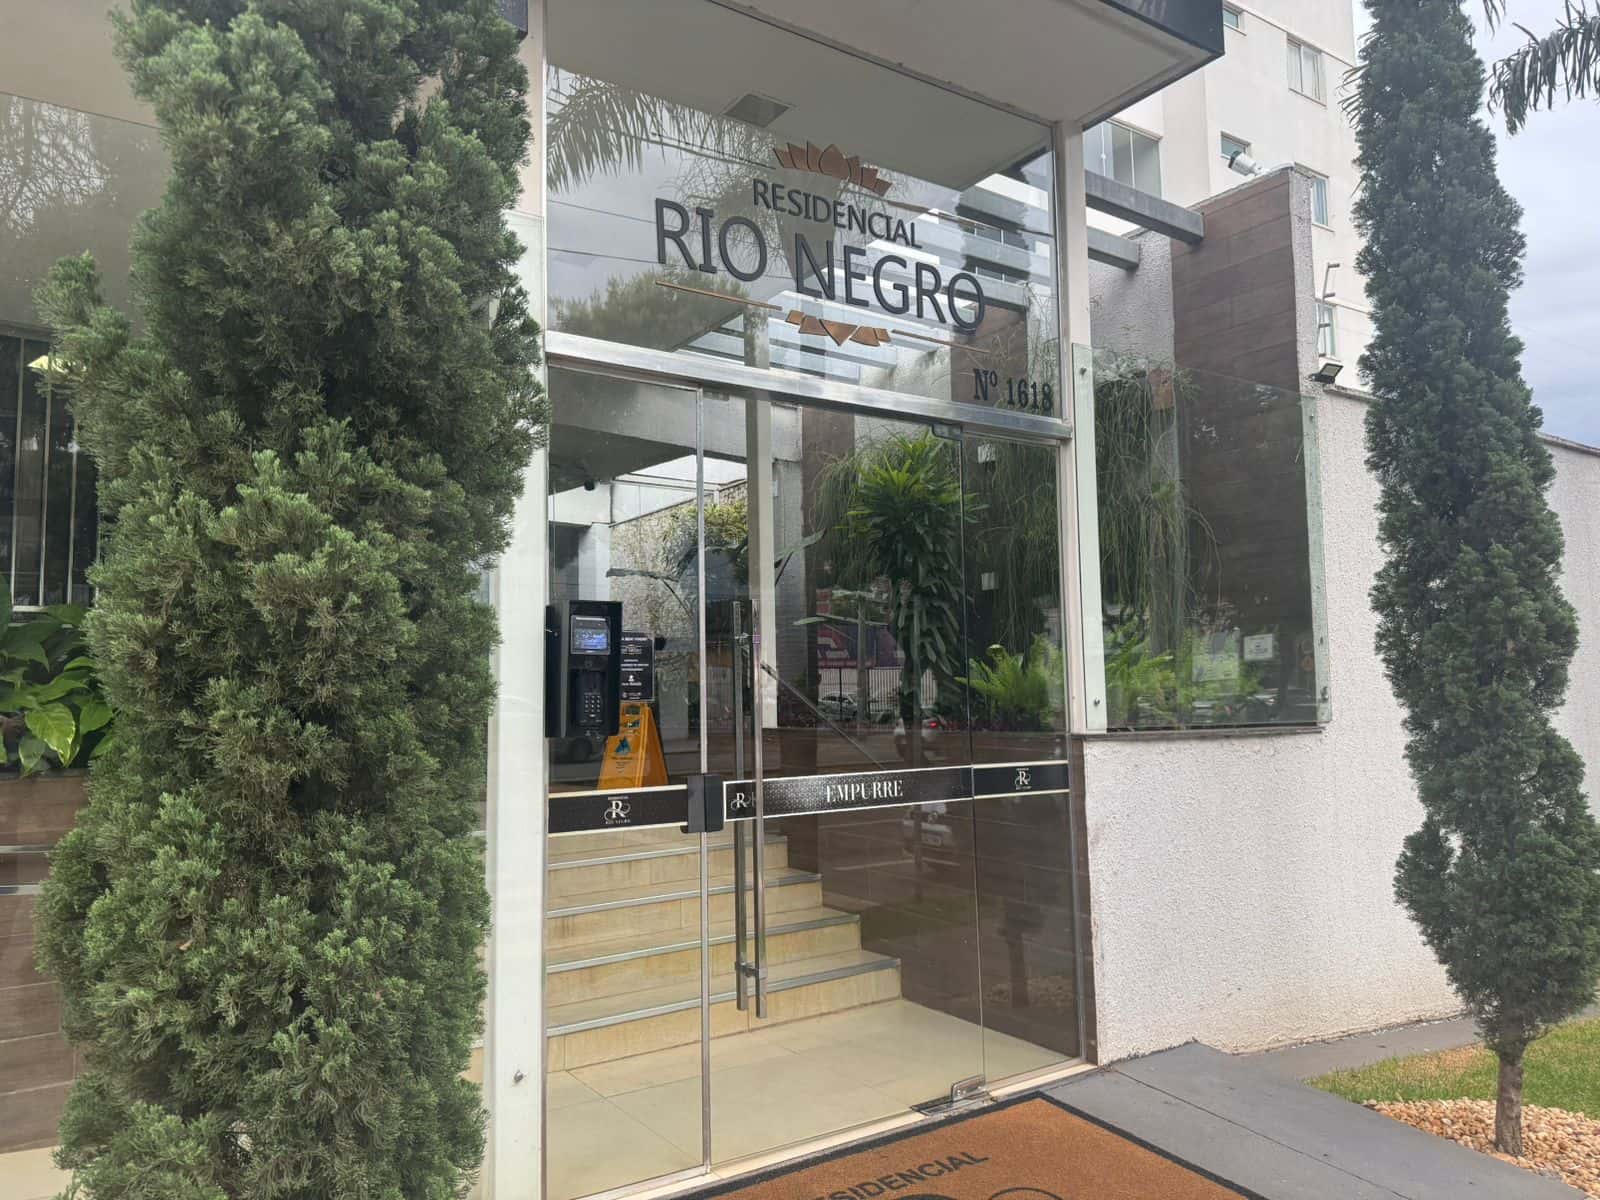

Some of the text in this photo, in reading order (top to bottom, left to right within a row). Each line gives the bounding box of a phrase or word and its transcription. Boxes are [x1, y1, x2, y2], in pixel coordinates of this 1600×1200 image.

[752, 178, 922, 249] RESIDENCIAL
[655, 198, 985, 334] RIO NEGRO
[1007, 378, 1054, 413] 1618
[826, 779, 904, 803] EMPURRE
